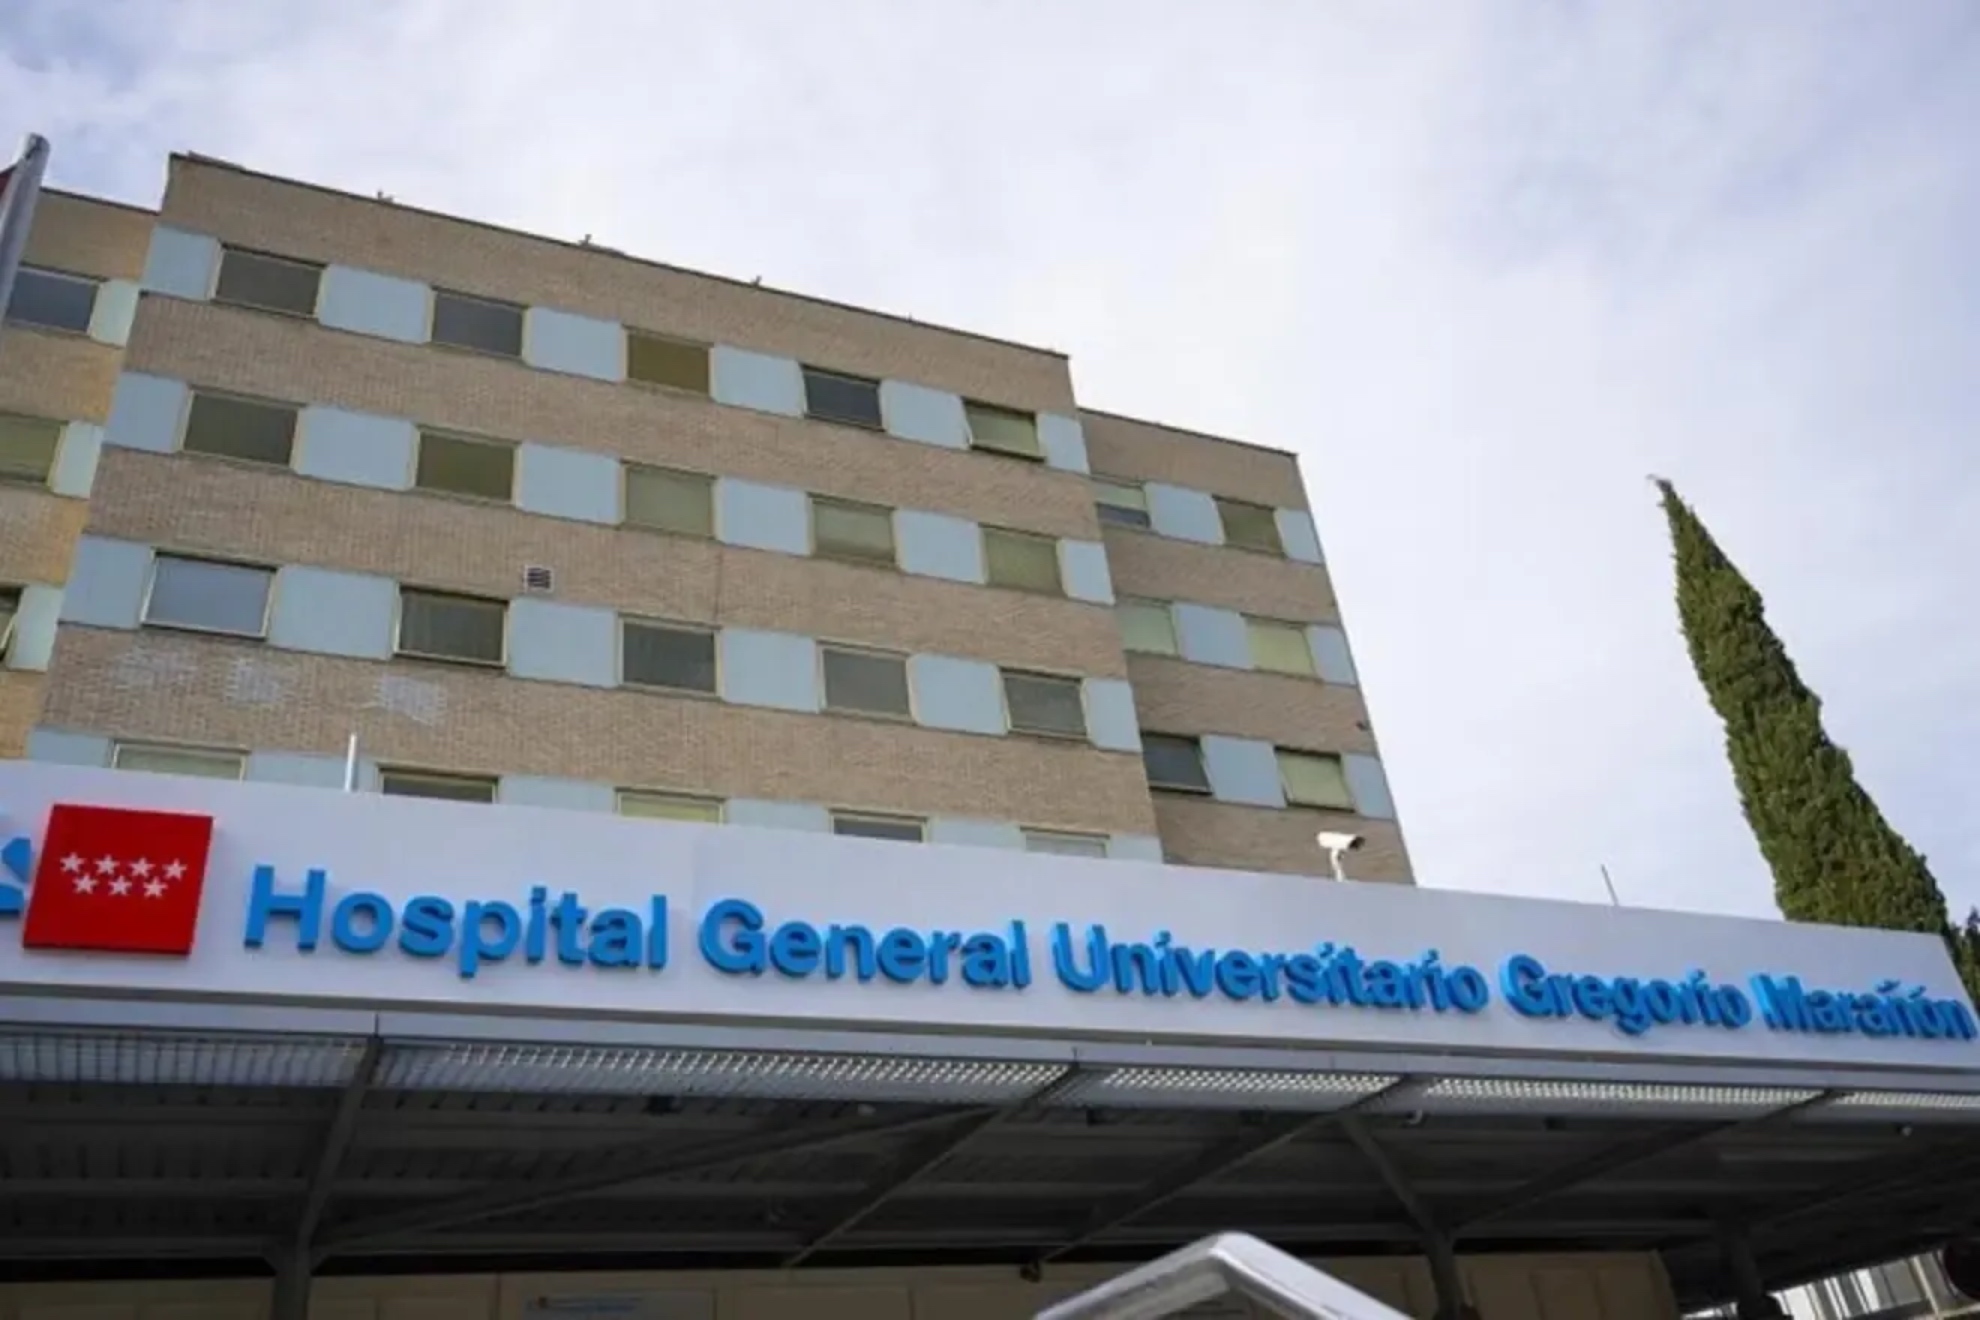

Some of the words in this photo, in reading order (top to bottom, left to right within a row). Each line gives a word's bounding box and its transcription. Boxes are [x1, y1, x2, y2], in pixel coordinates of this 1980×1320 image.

[245, 865, 667, 977] Hospital
[699, 898, 1030, 988] General
[1053, 922, 1488, 1012] Universitario
[1501, 954, 1750, 1035] Gregorio
[1754, 974, 1976, 1040] Marañón
